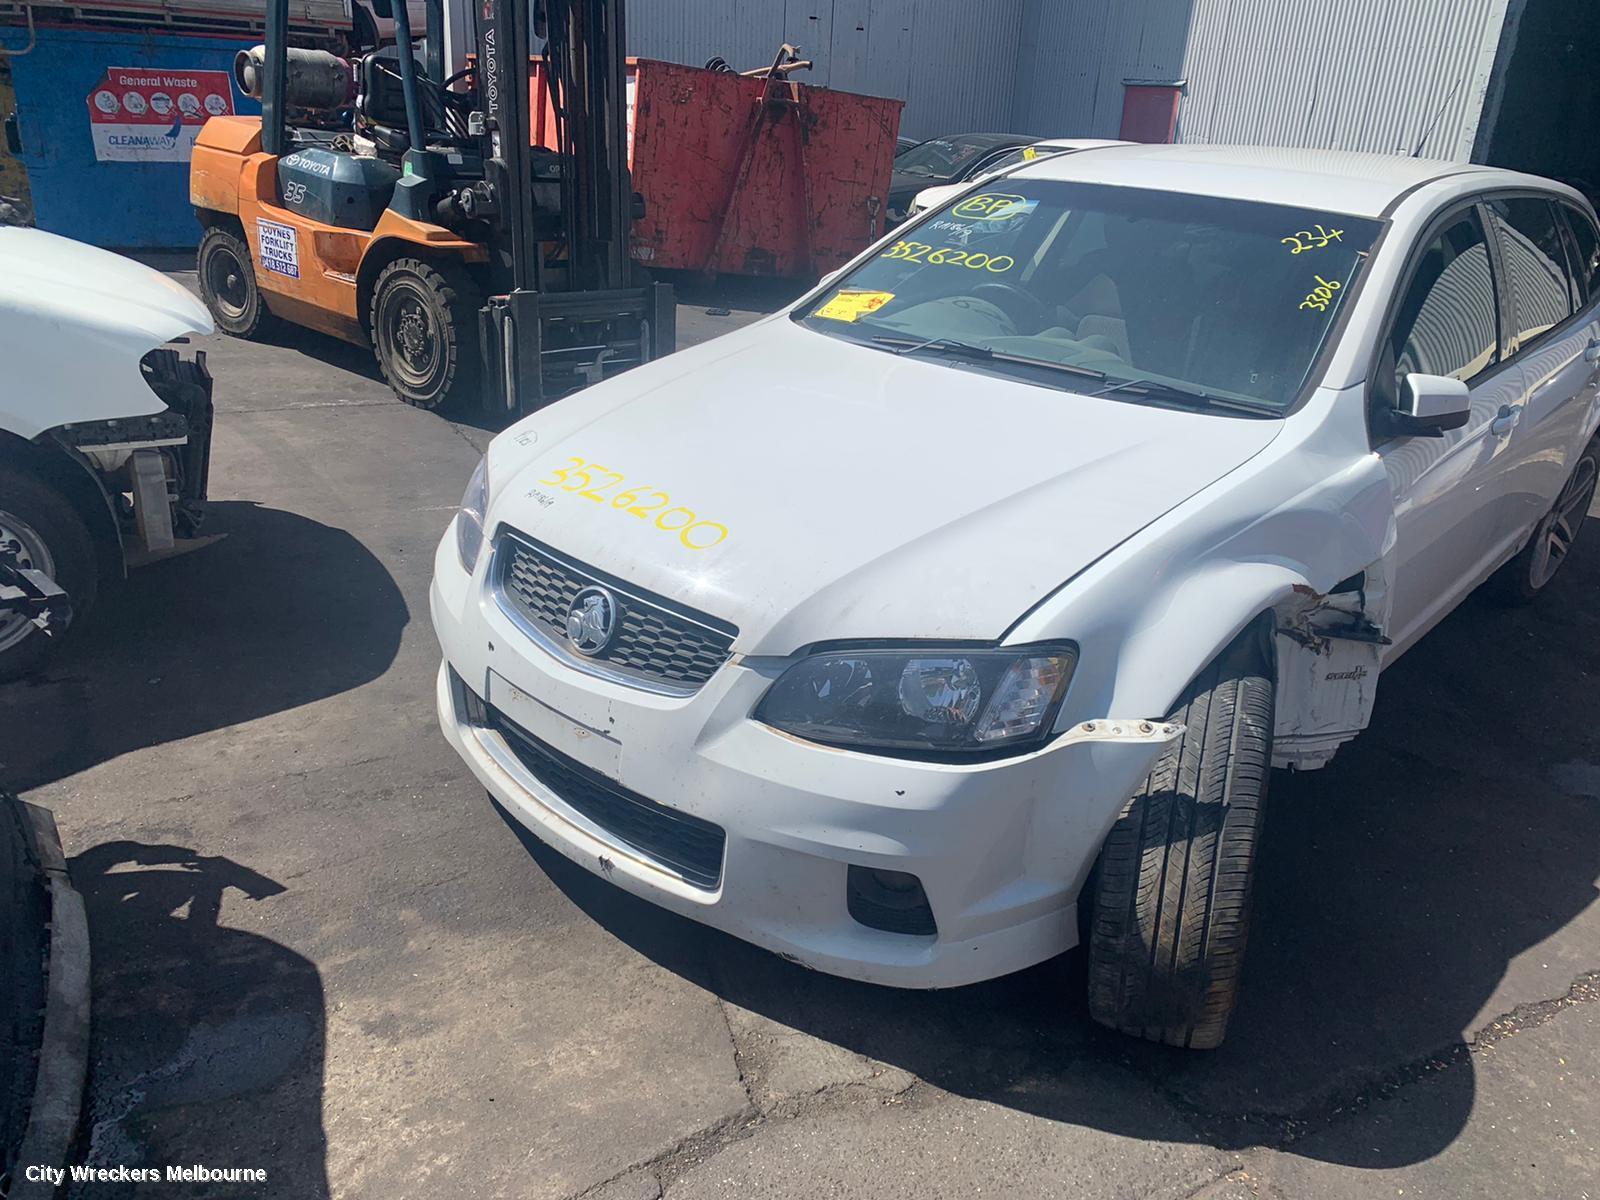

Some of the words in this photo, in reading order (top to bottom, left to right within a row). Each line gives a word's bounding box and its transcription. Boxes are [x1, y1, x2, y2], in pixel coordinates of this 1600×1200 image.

[484, 28, 499, 114] TOYOTA
[119, 75, 161, 87] General
[163, 76, 198, 88] Waste
[108, 135, 175, 148] CLEANAWAY
[298, 158, 330, 176] TOYOTA
[283, 181, 307, 204] 35
[961, 196, 1013, 215] BP
[262, 225, 291, 240] COYNES
[261, 234, 294, 251] FORKLIFT
[264, 246, 293, 262] TRUCKS
[880, 240, 1015, 272] 3526200
[1299, 275, 1341, 311] 3306
[538, 457, 729, 550] 3526200
